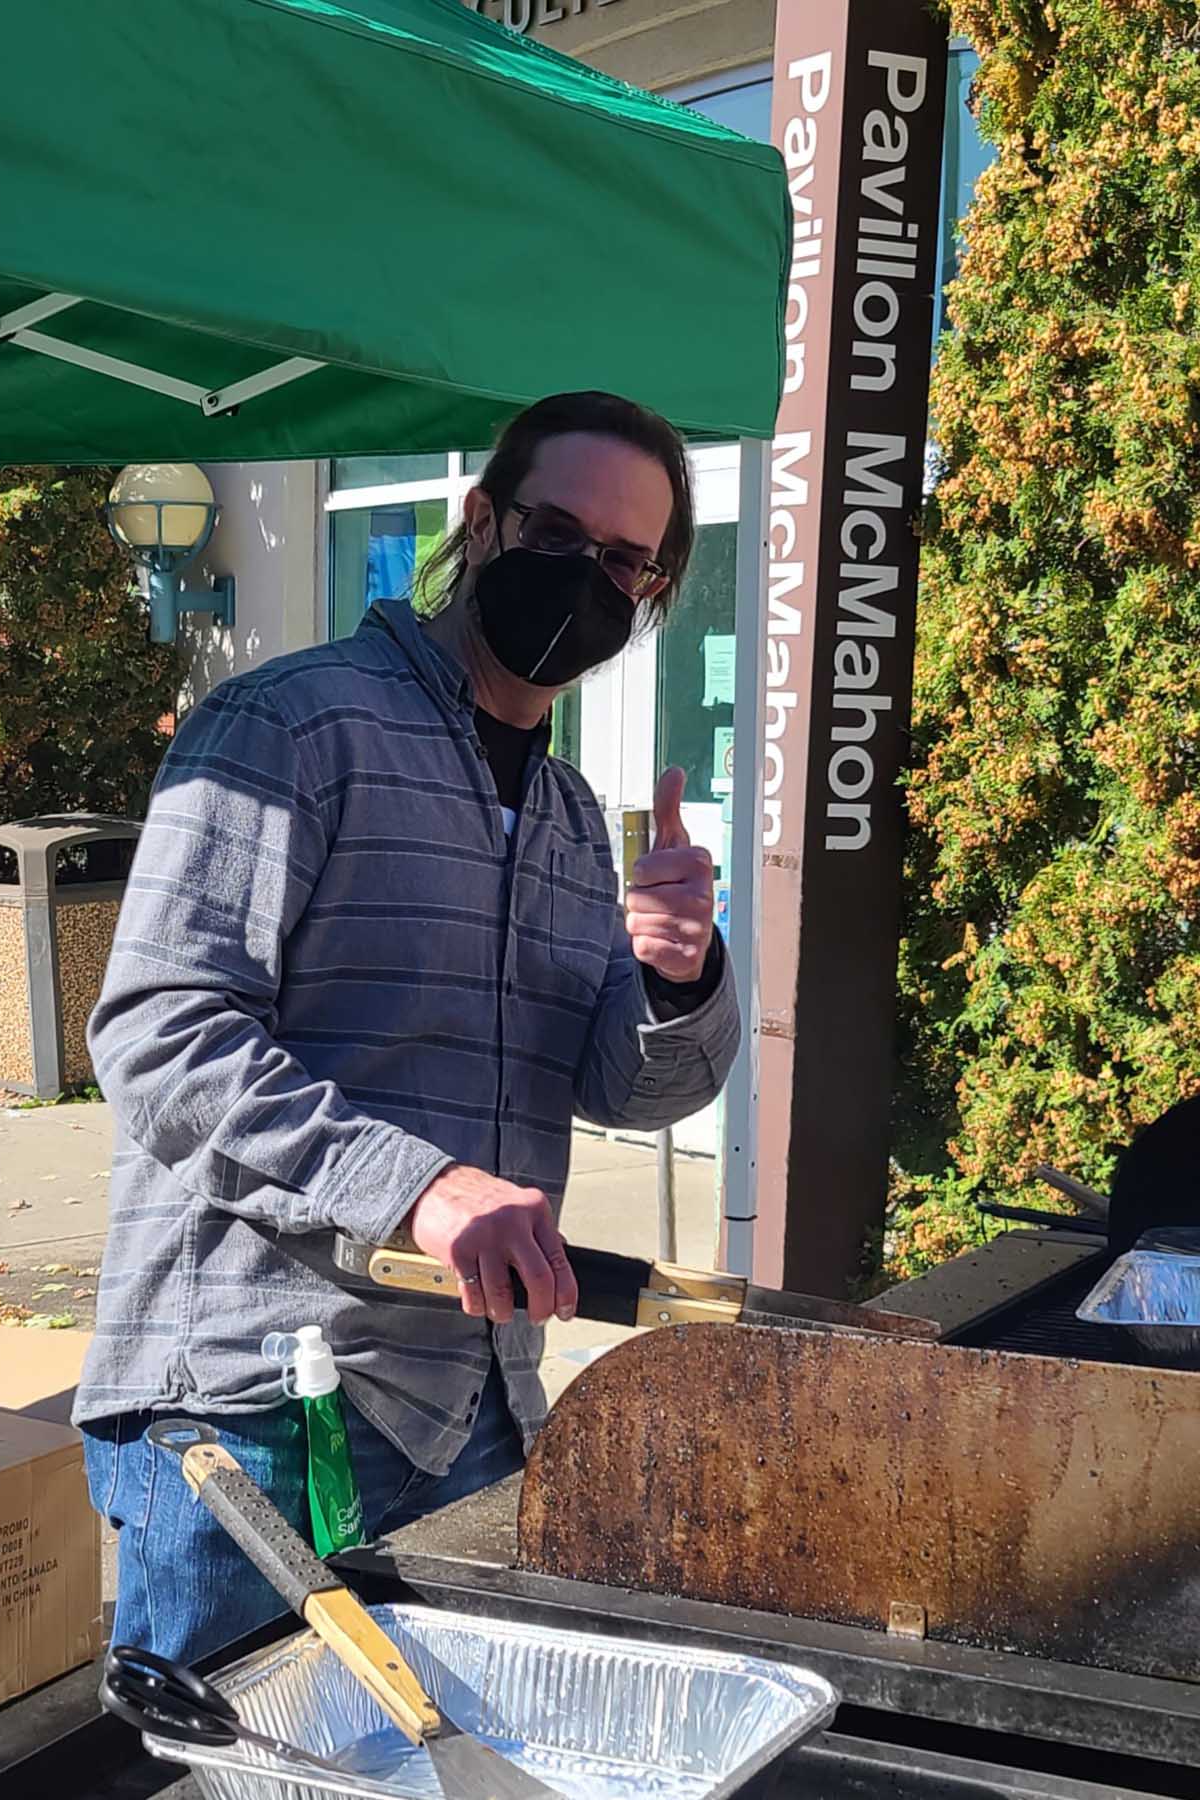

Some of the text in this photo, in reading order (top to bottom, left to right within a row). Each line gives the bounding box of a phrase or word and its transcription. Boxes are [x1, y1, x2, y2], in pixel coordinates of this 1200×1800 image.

[825, 50, 928, 850] Pavillon McMahon
[2, 1594, 12, 1608] IN
[13, 1583, 41, 1603] CHINA
